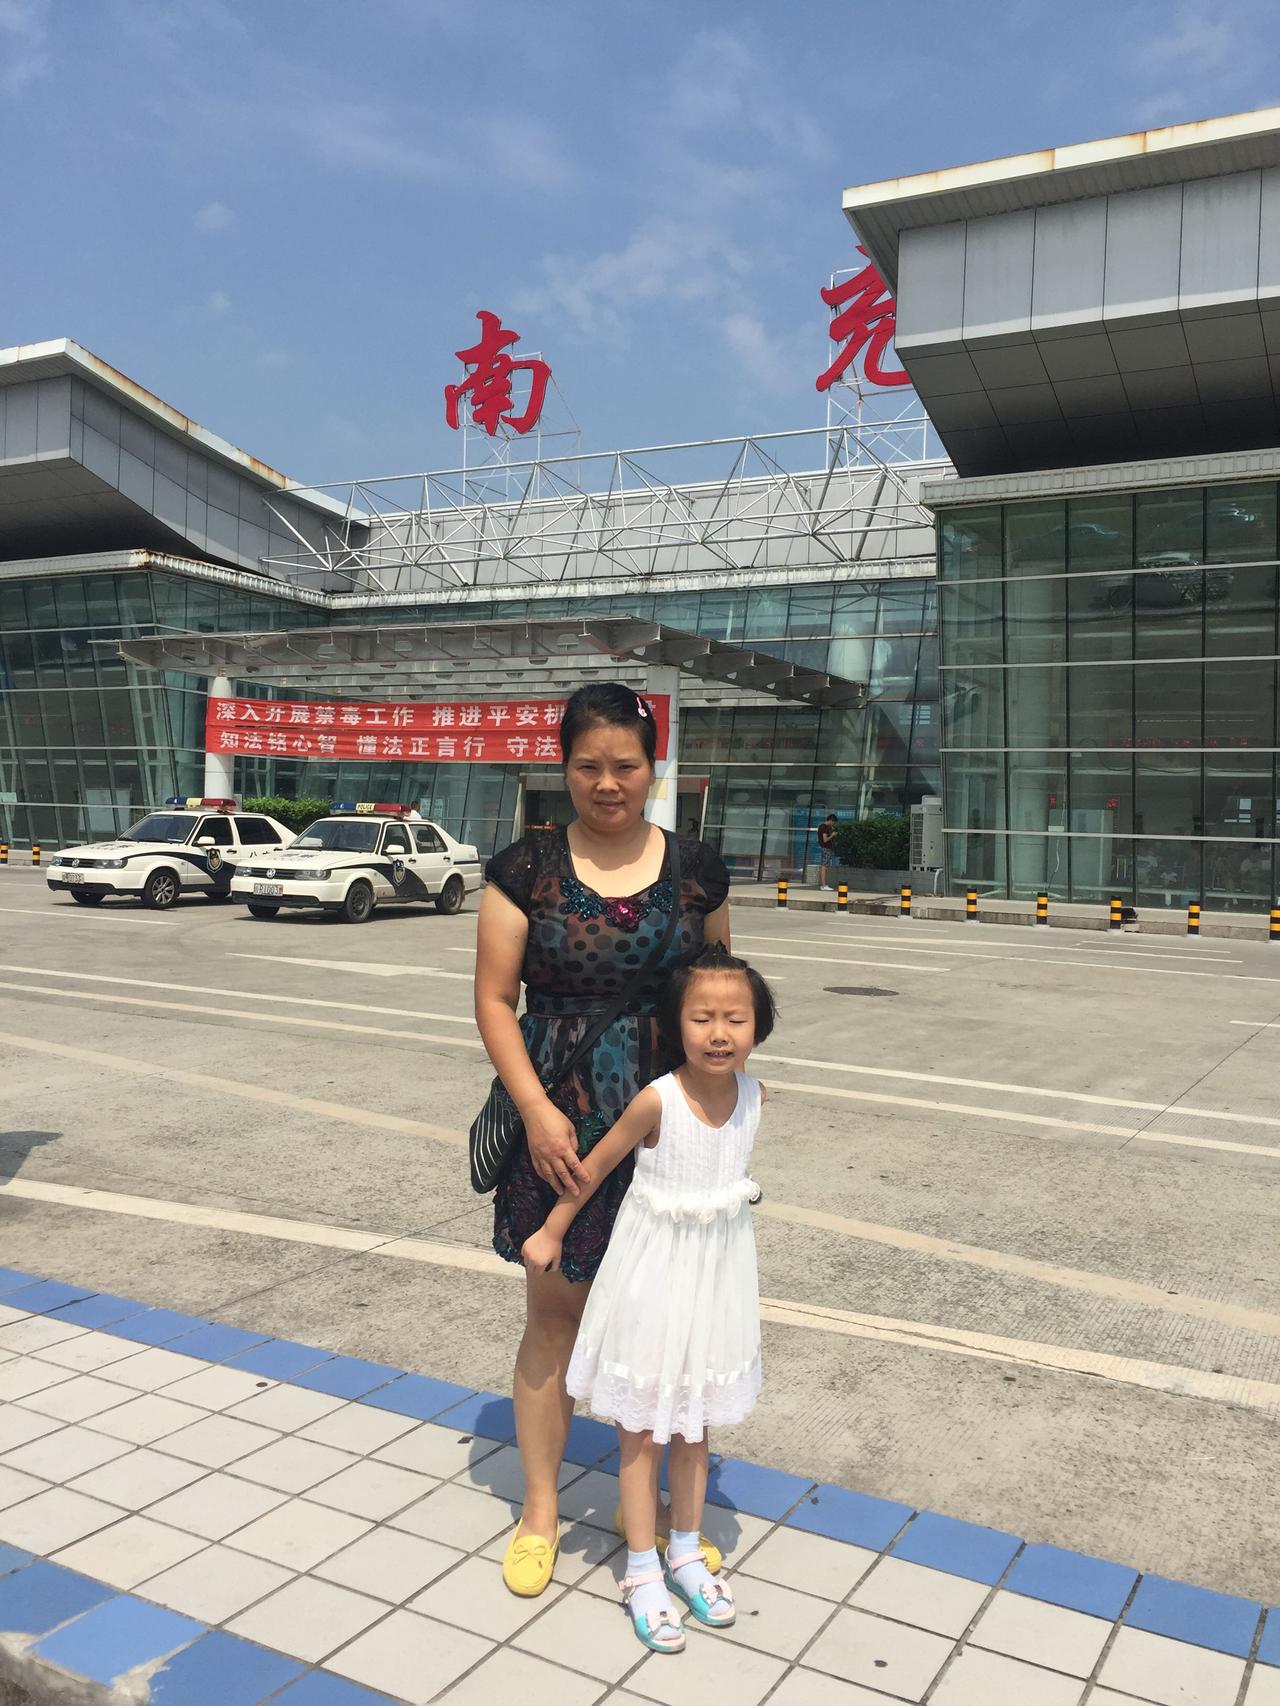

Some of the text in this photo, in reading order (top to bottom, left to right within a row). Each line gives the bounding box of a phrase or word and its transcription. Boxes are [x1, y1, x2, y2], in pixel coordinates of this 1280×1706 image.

[445, 311, 551, 436] 南
[216, 702, 415, 727] 深入开展禁毒工作
[356, 735, 485, 757] 懂法正言行
